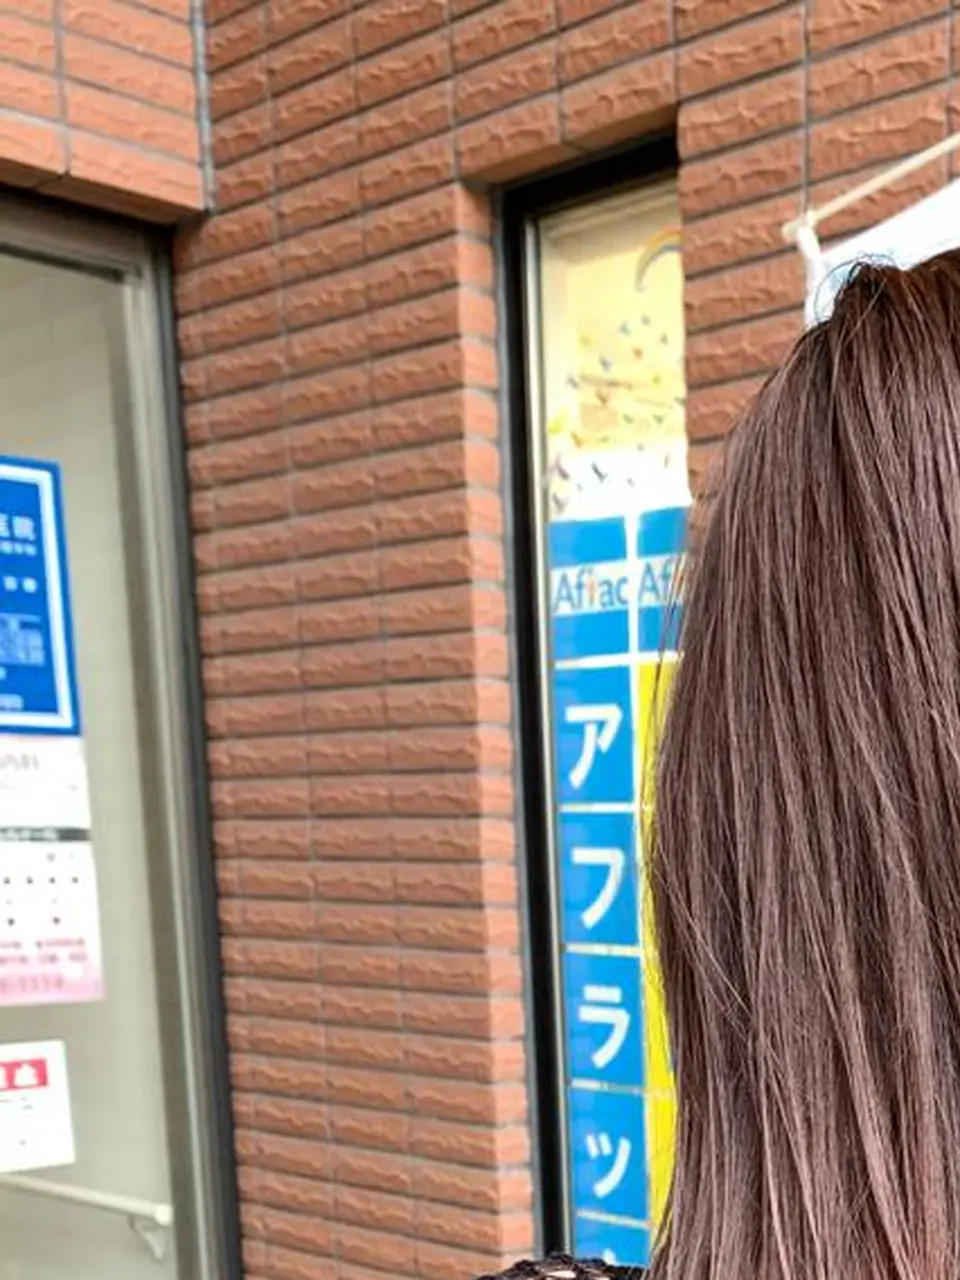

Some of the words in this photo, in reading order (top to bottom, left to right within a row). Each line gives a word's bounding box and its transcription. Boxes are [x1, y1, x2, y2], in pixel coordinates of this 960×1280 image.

[552, 566, 629, 613] Aflac
[638, 559, 678, 604] Af
[564, 703, 632, 1265] アフラッ
